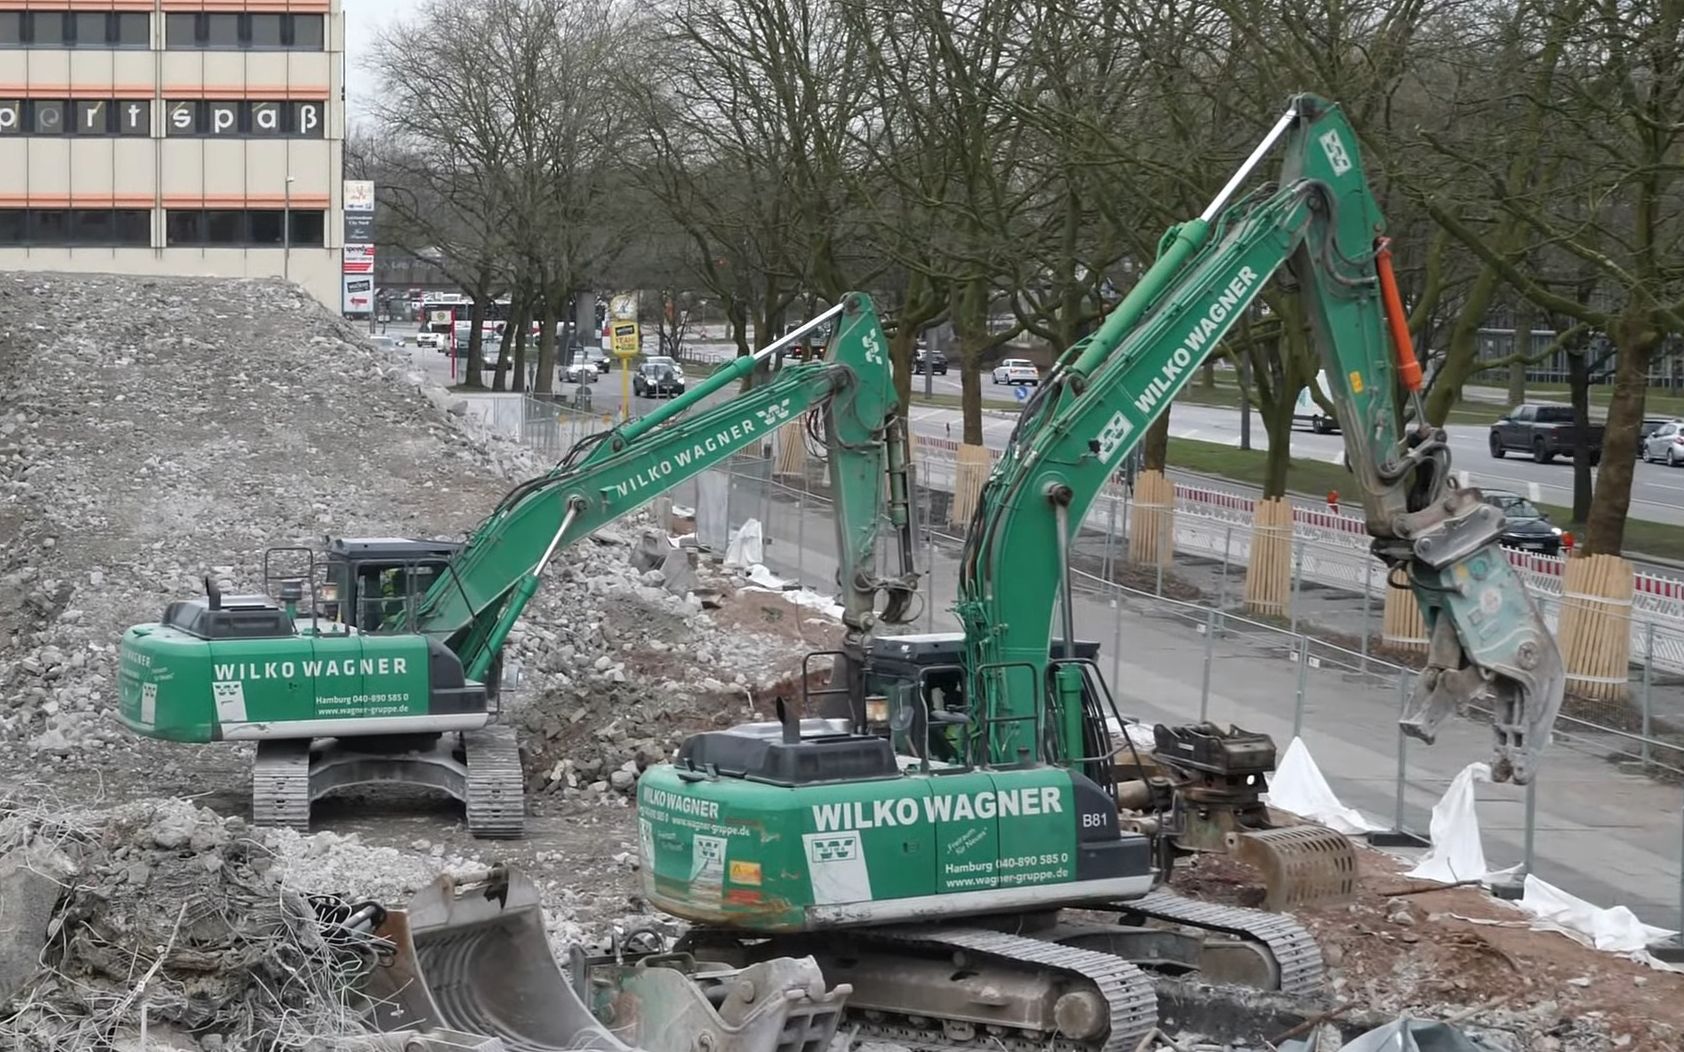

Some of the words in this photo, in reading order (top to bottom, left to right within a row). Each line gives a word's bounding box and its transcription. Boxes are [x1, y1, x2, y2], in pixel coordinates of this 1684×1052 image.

[1134, 348, 1191, 414] WILKO
[1184, 265, 1258, 352] WAGNER
[674, 418, 755, 467] WAGNER
[214, 661, 295, 681] WILKO
[302, 657, 407, 677] WAGNER
[315, 695, 351, 706] Hamburg
[352, 693, 387, 704] 040-890
[387, 693, 403, 703] 585
[403, 693, 409, 702] 0
[318, 704, 409, 717] www.wagner-gruppe.de
[667, 792, 720, 819] WAGNER
[812, 798, 919, 832] WILKO
[922, 786, 1063, 824] WAGNER
[1082, 812, 1107, 828] B81
[945, 861, 993, 874] Hamburg
[995, 855, 1038, 869] 040-890
[1039, 853, 1059, 866] 585
[1061, 852, 1069, 863] 0
[945, 866, 1069, 888] www.wagner-gruppe.de
